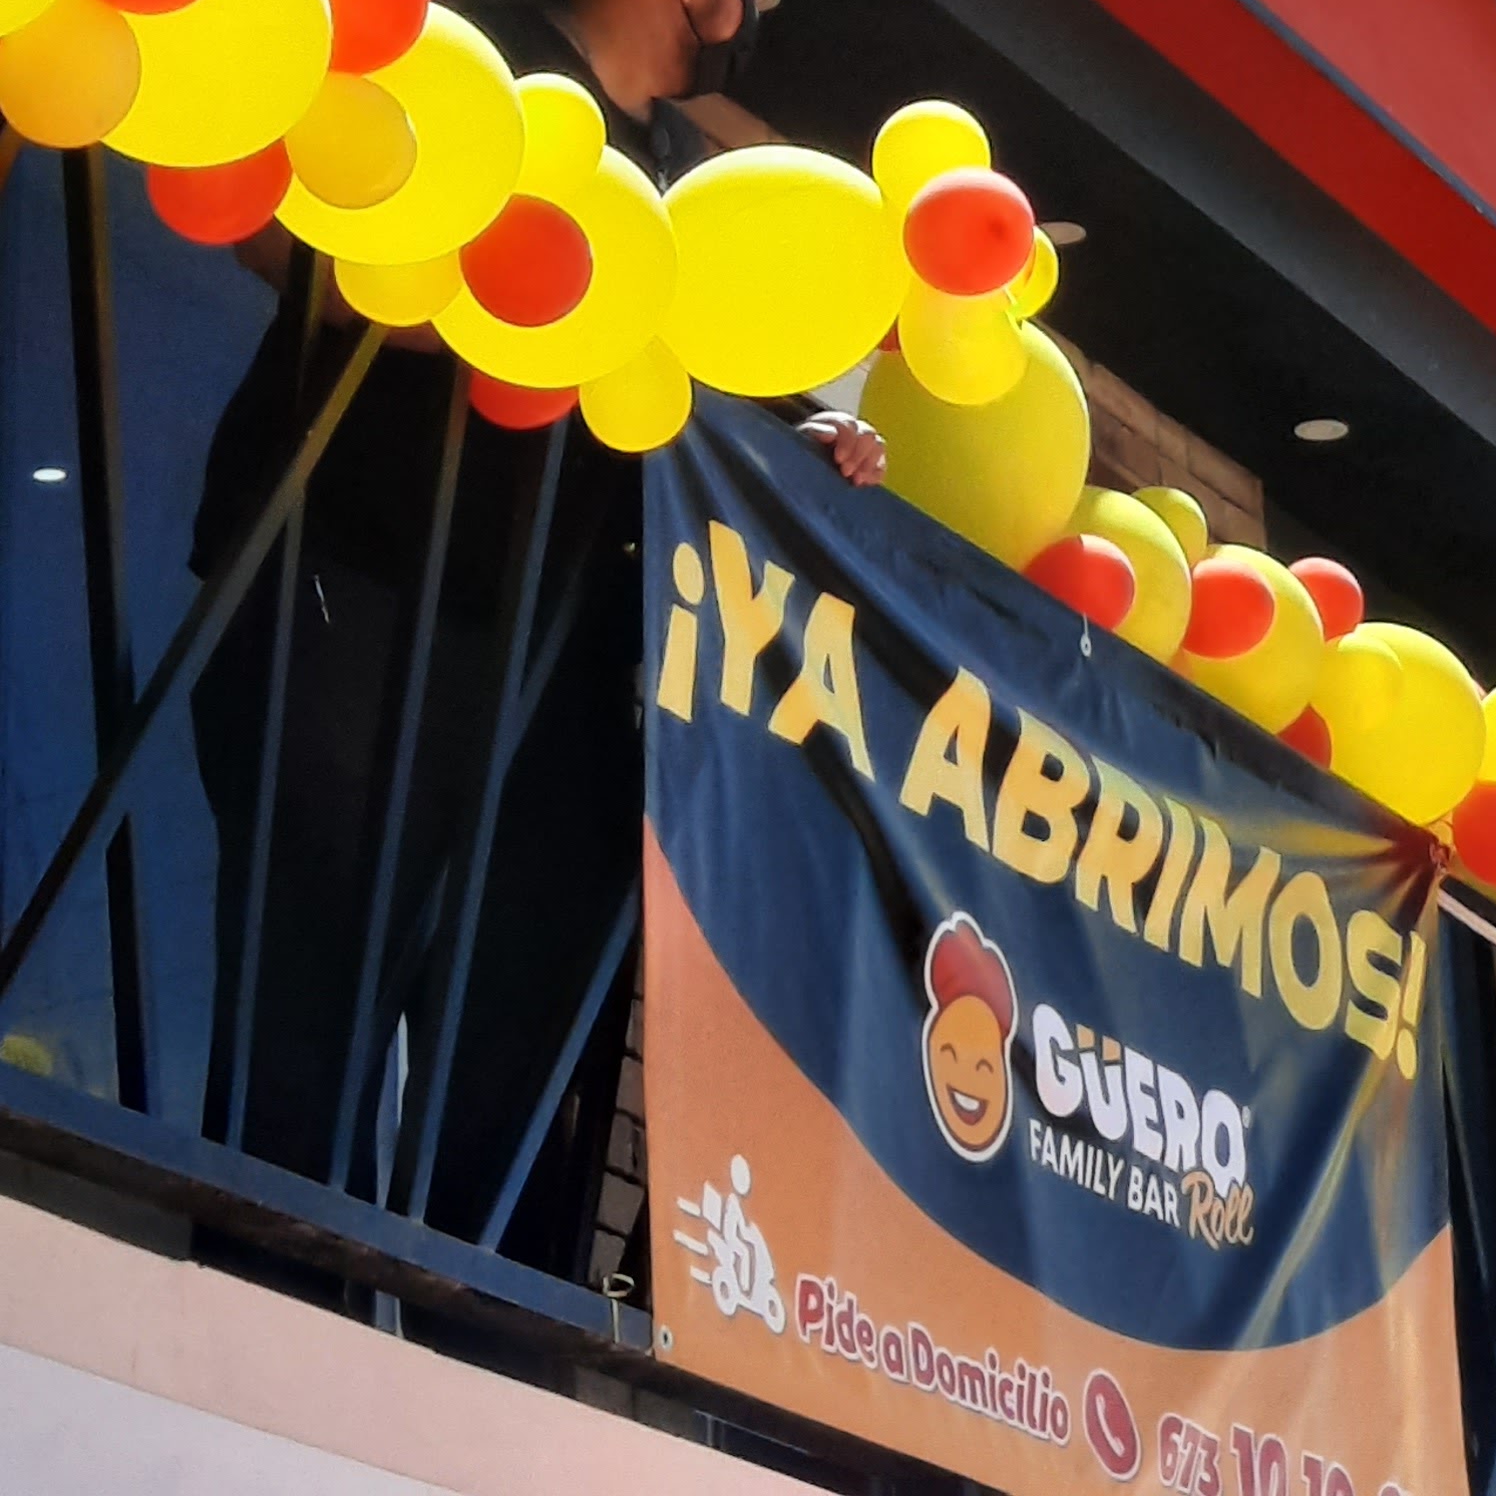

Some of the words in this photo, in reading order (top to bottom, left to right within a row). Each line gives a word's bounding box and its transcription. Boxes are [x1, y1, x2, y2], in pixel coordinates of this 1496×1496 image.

[657, 520, 876, 782] ¡YA
[900, 666, 1426, 1079] ABRIMOS!
[1029, 1118, 1125, 1200] FAMILY
[1127, 1165, 1180, 1228] BAR
[1181, 1170, 1254, 1250] Roll
[1033, 1004, 1246, 1198] GÜERO
[795, 1273, 877, 1369] Pide
[880, 1325, 908, 1382] a
[908, 1322, 1070, 1445] Domicilio
[1158, 1413, 1222, 1496] 673
